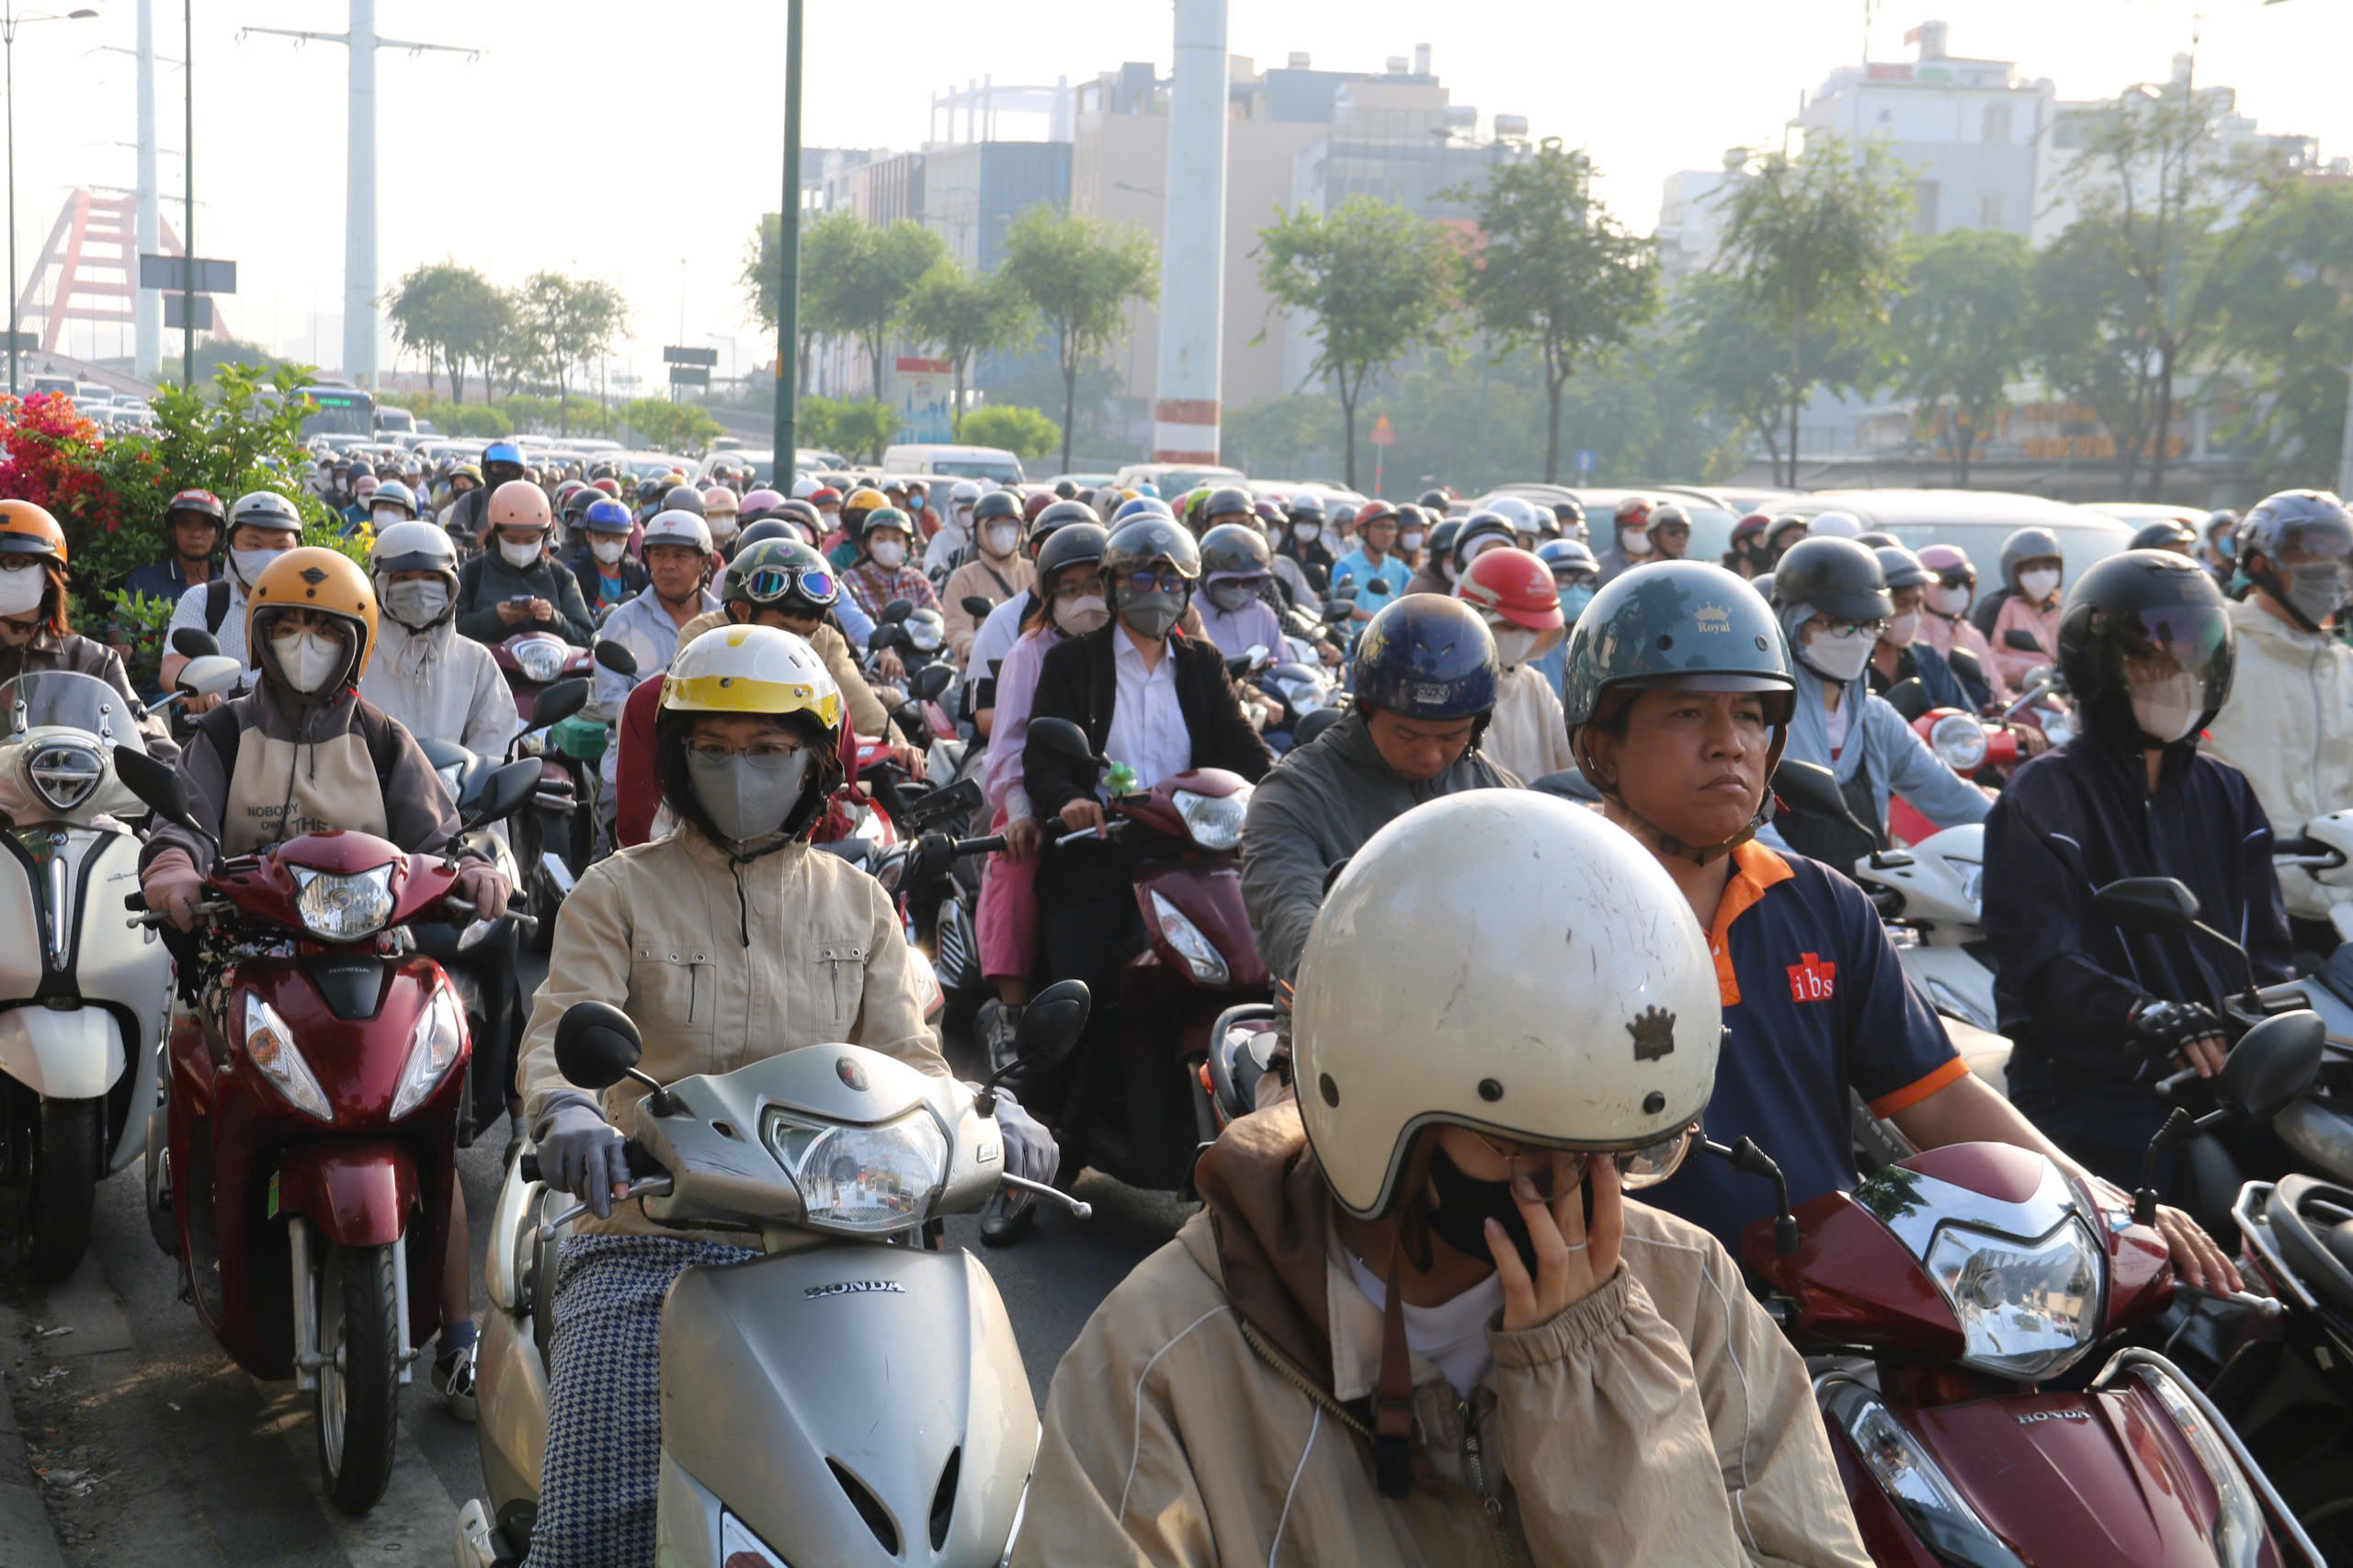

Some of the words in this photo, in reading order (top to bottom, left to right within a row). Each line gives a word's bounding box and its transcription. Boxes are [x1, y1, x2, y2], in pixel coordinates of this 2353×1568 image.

[1699, 622, 1731, 635] Royal
[291, 816, 328, 834] THE
[1796, 967, 1834, 1000] ibs
[2015, 1408, 2091, 1424] HONDA
